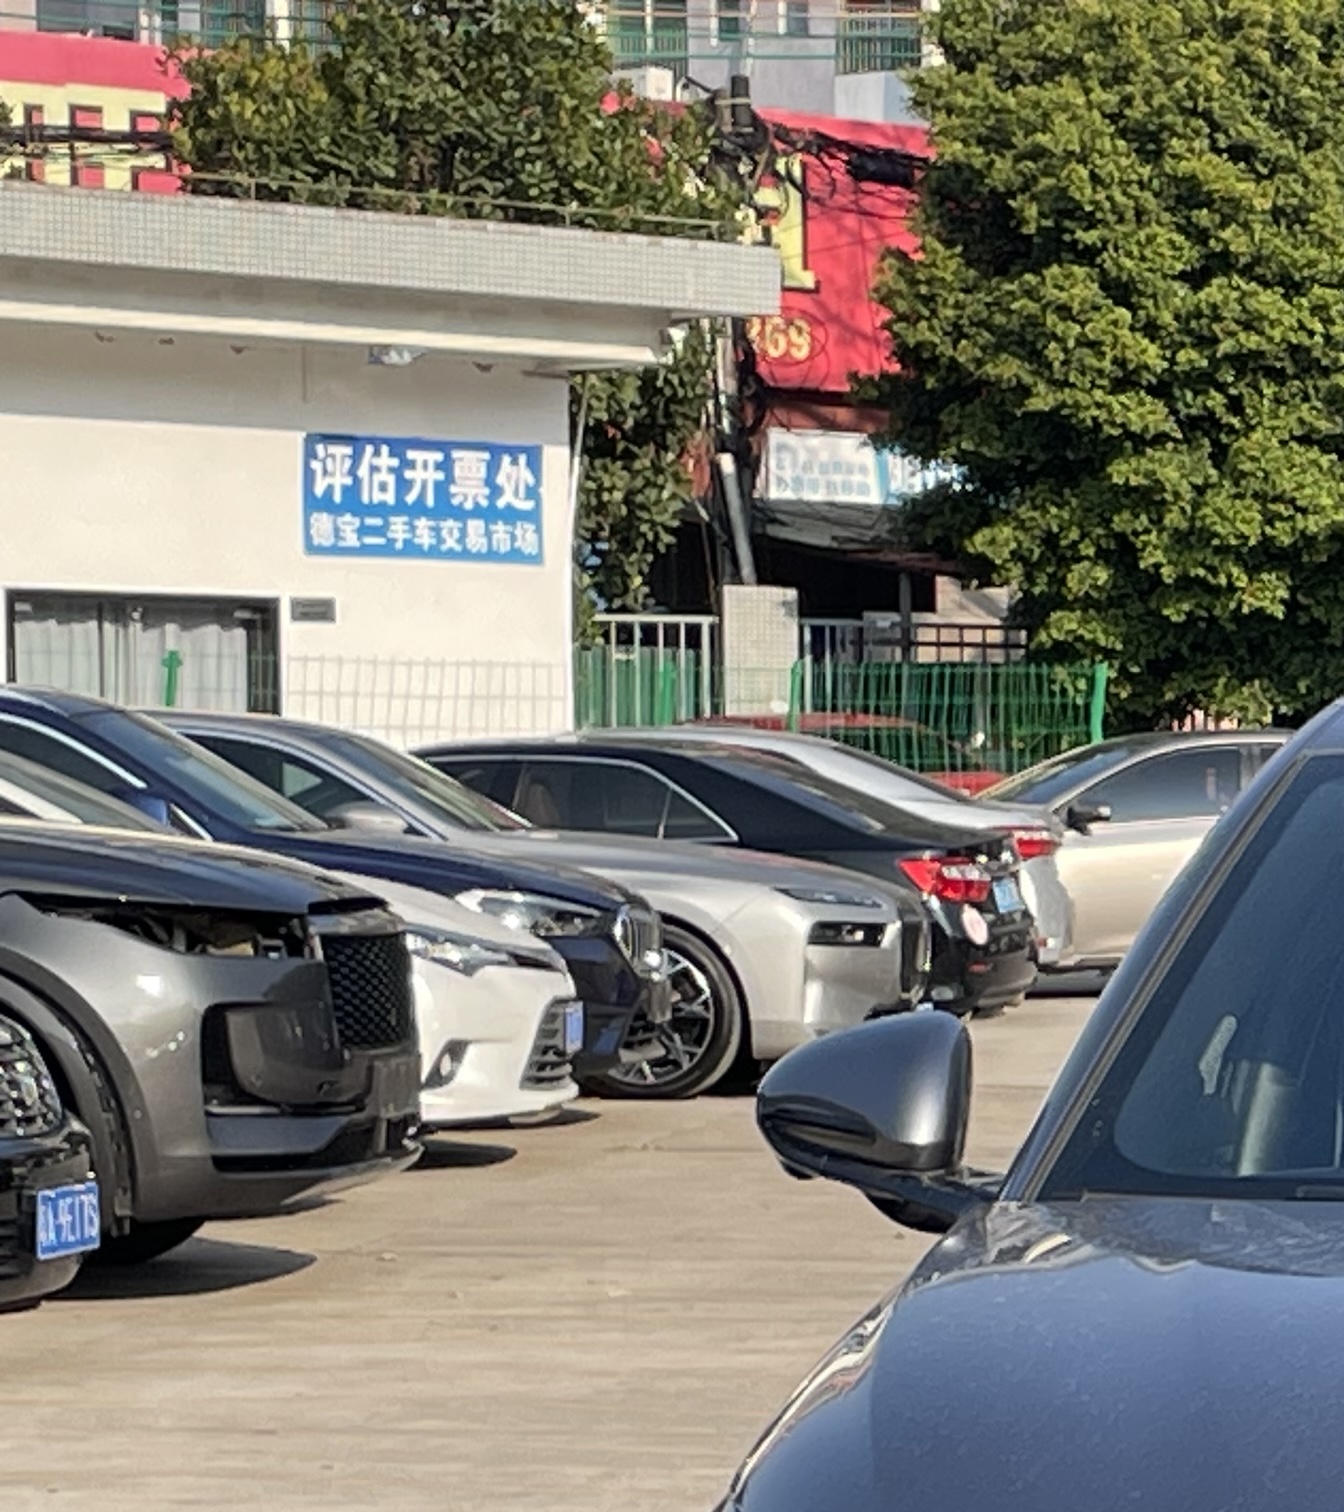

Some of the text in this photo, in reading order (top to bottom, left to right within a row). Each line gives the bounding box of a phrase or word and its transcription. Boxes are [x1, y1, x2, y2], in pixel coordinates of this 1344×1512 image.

[310, 443, 536, 510] 评估开票处
